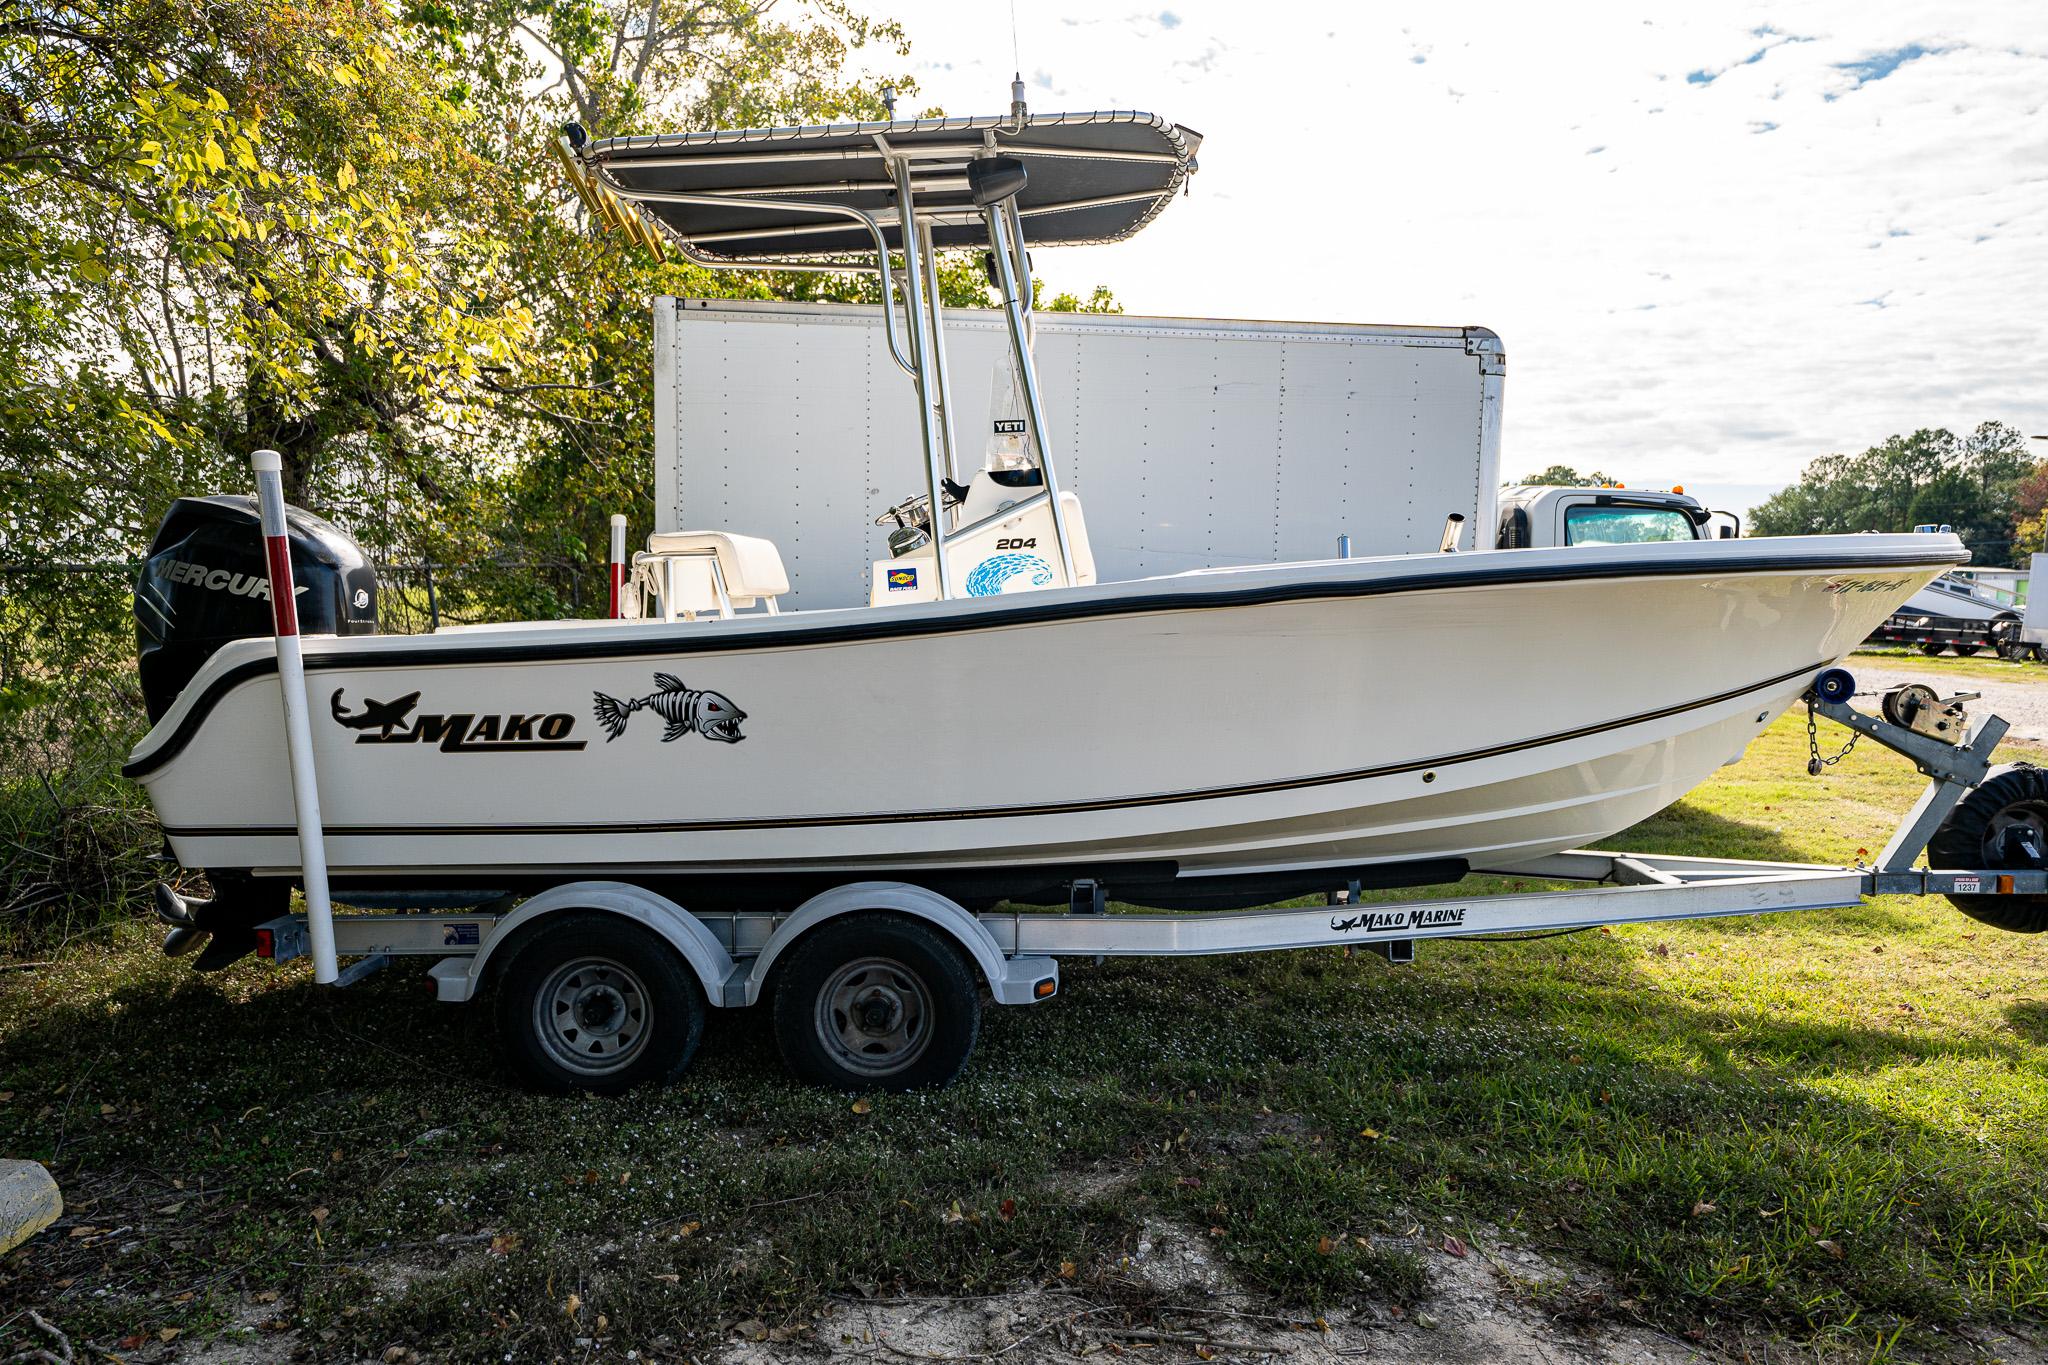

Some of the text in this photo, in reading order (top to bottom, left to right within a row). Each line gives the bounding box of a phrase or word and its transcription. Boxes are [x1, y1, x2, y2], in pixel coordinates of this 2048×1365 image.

[995, 421, 1024, 432] YETI
[996, 538, 1037, 550] 204
[155, 559, 309, 601] MERCUR
[411, 712, 577, 753] MAKO
[1958, 883, 1977, 892] 1237
[1358, 908, 1467, 932] MAKO MARINE
